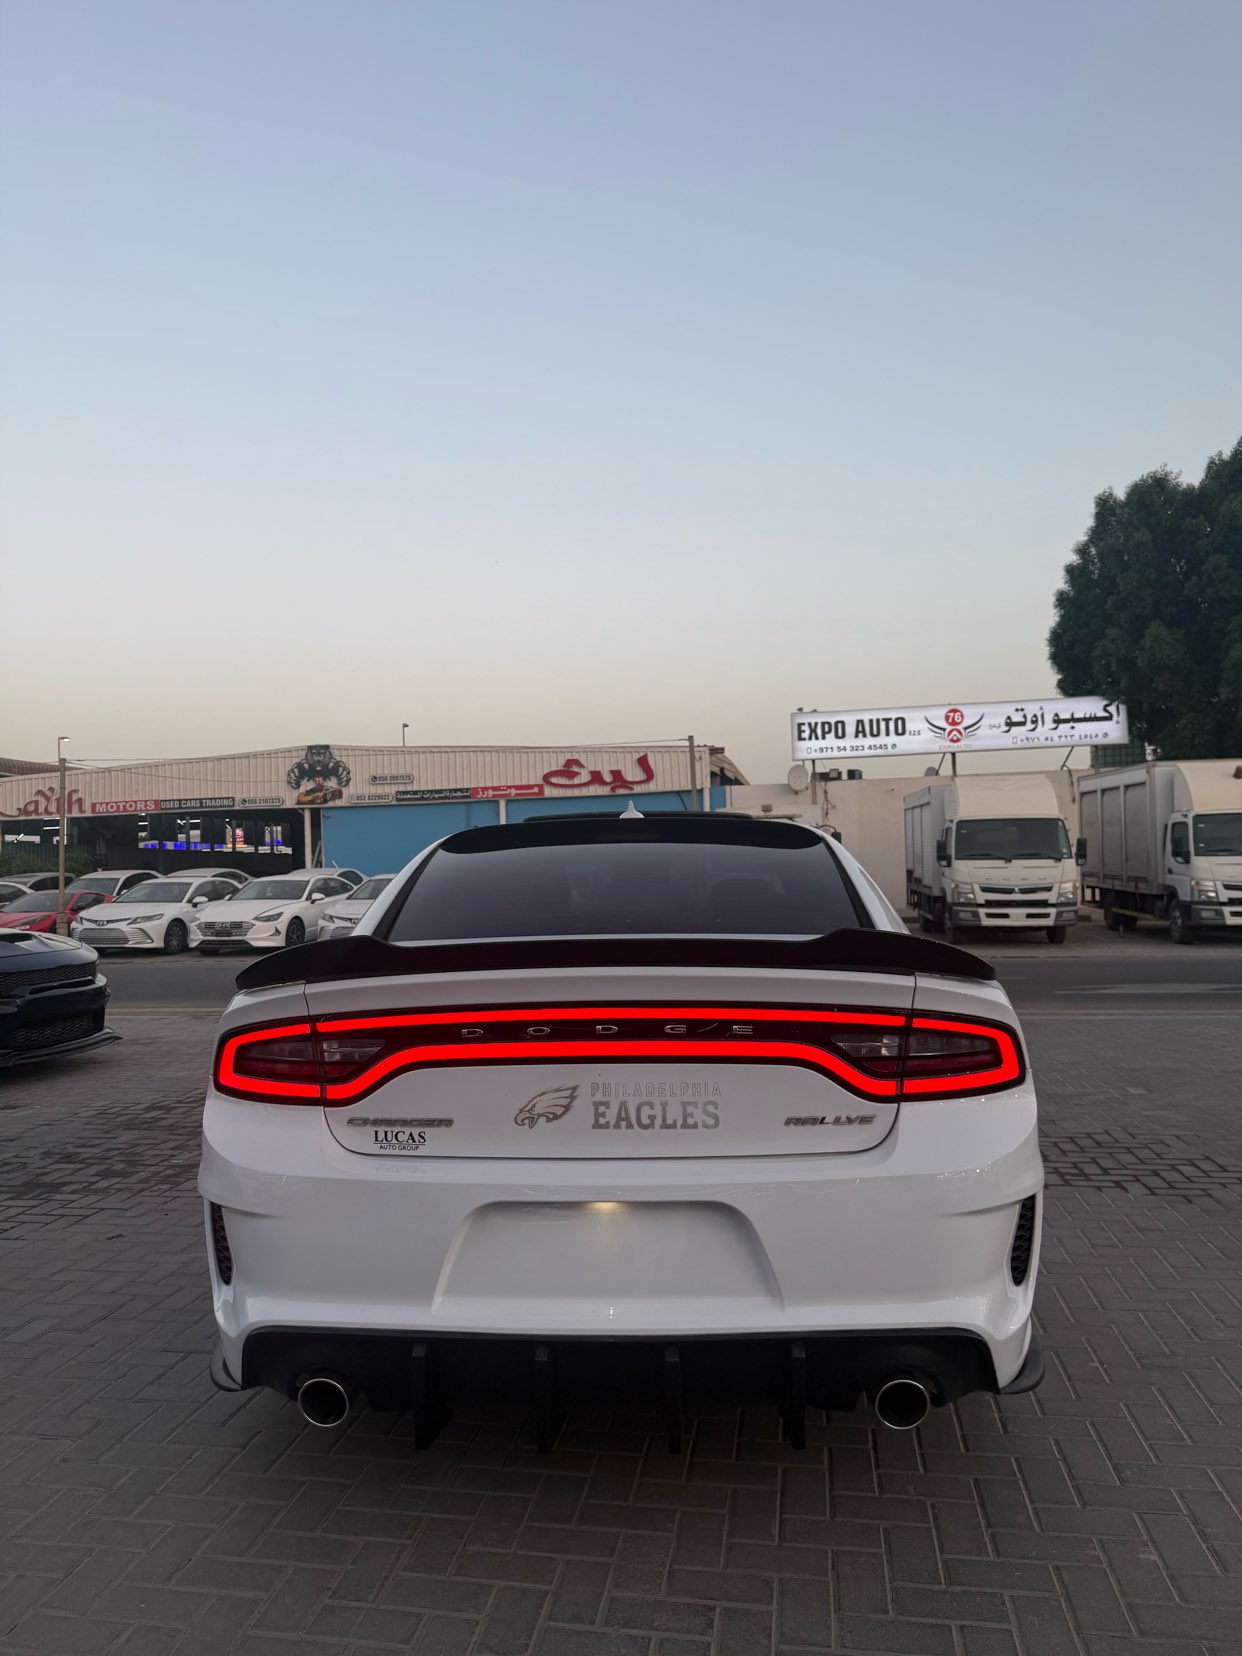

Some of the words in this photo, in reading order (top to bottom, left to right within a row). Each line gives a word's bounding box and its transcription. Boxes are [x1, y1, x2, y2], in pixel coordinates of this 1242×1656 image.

[947, 712, 961, 723] 76
[1001, 705, 1045, 734] أوتو
[1050, 702, 1121, 731] إكسبو
[796, 720, 846, 742] EXPO
[854, 717, 907, 739] AUTO
[813, 746, 834, 754] +971
[849, 744, 865, 752] 323
[867, 743, 889, 751] 4545
[543, 753, 654, 793] ليث
[95, 800, 155, 813] MOTORS
[160, 799, 180, 808] USED
[181, 798, 200, 808] CARS
[201, 797, 234, 807] TRADING
[461, 1024, 753, 1037] DODGE
[590, 1081, 722, 1098] PHILADELPHIA
[591, 1100, 721, 1130] EAGLES
[784, 1114, 877, 1126] RALLYE
[373, 1130, 427, 1144] LUCAS
[397, 1144, 420, 1152] GROUP
